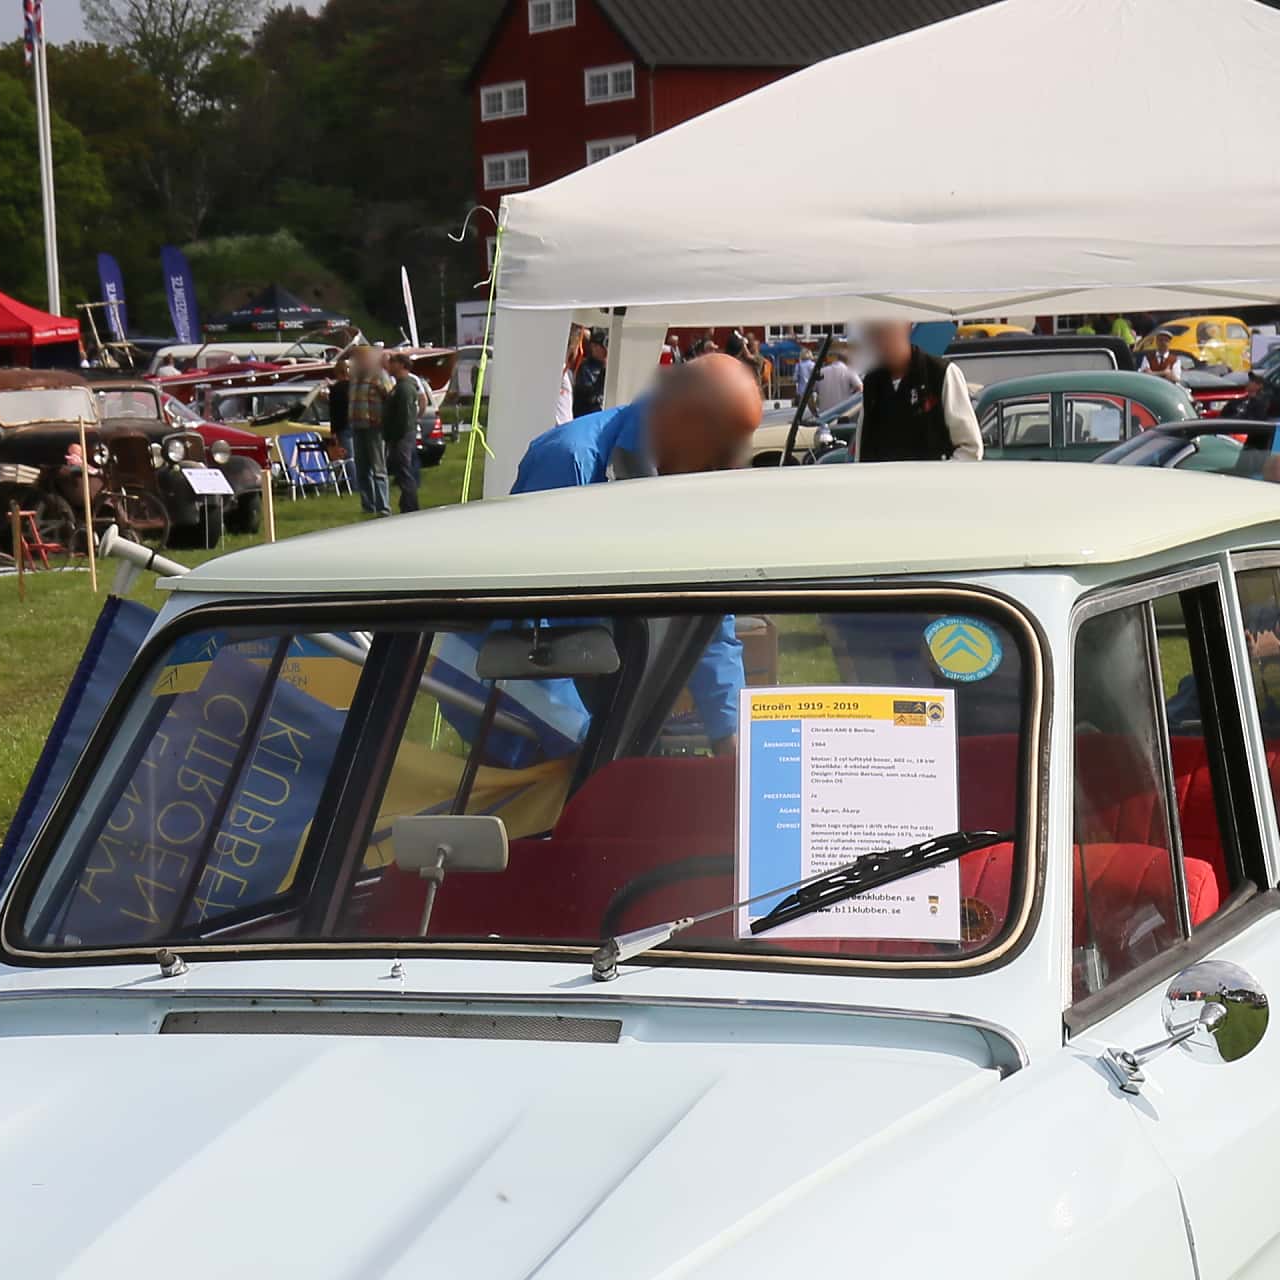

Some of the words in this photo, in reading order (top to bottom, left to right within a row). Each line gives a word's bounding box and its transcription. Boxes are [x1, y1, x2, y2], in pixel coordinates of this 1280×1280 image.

[752, 702, 792, 712] Citroën
[798, 702, 824, 710] 1919
[834, 702, 859, 710] 2019
